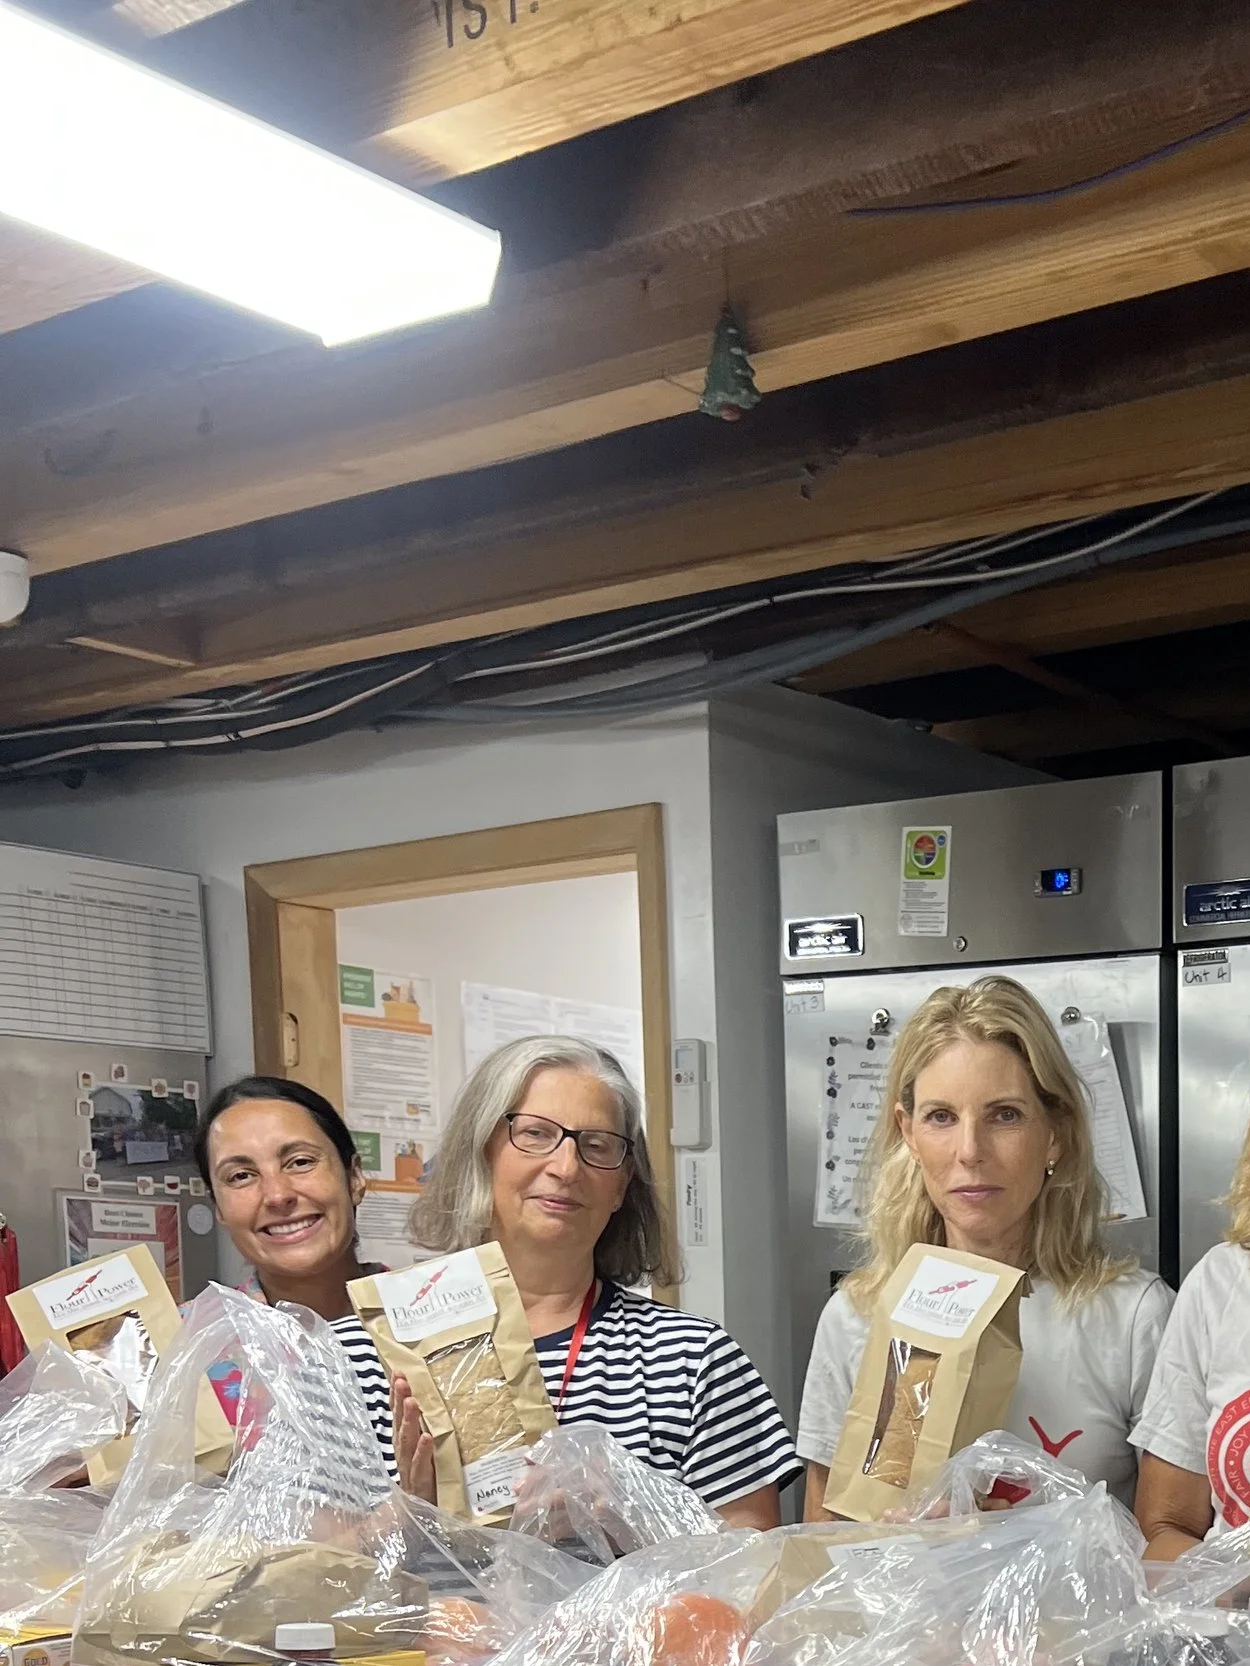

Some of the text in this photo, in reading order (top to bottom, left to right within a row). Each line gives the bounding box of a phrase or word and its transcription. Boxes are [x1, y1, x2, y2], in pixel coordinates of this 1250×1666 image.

[1200, 896, 1238, 912] arctic
[1184, 966, 1228, 984] Unit 4
[856, 1102, 874, 1110] CAST
[50, 1297, 86, 1314] Flour
[97, 1277, 136, 1298] Power
[392, 1302, 430, 1320] Flour
[440, 1284, 484, 1306] Power
[1215, 1406, 1238, 1436] EAST
[1231, 1430, 1248, 1458] JOY
[476, 1484, 511, 1502] Nancy
[1228, 1470, 1250, 1499] FAIR
